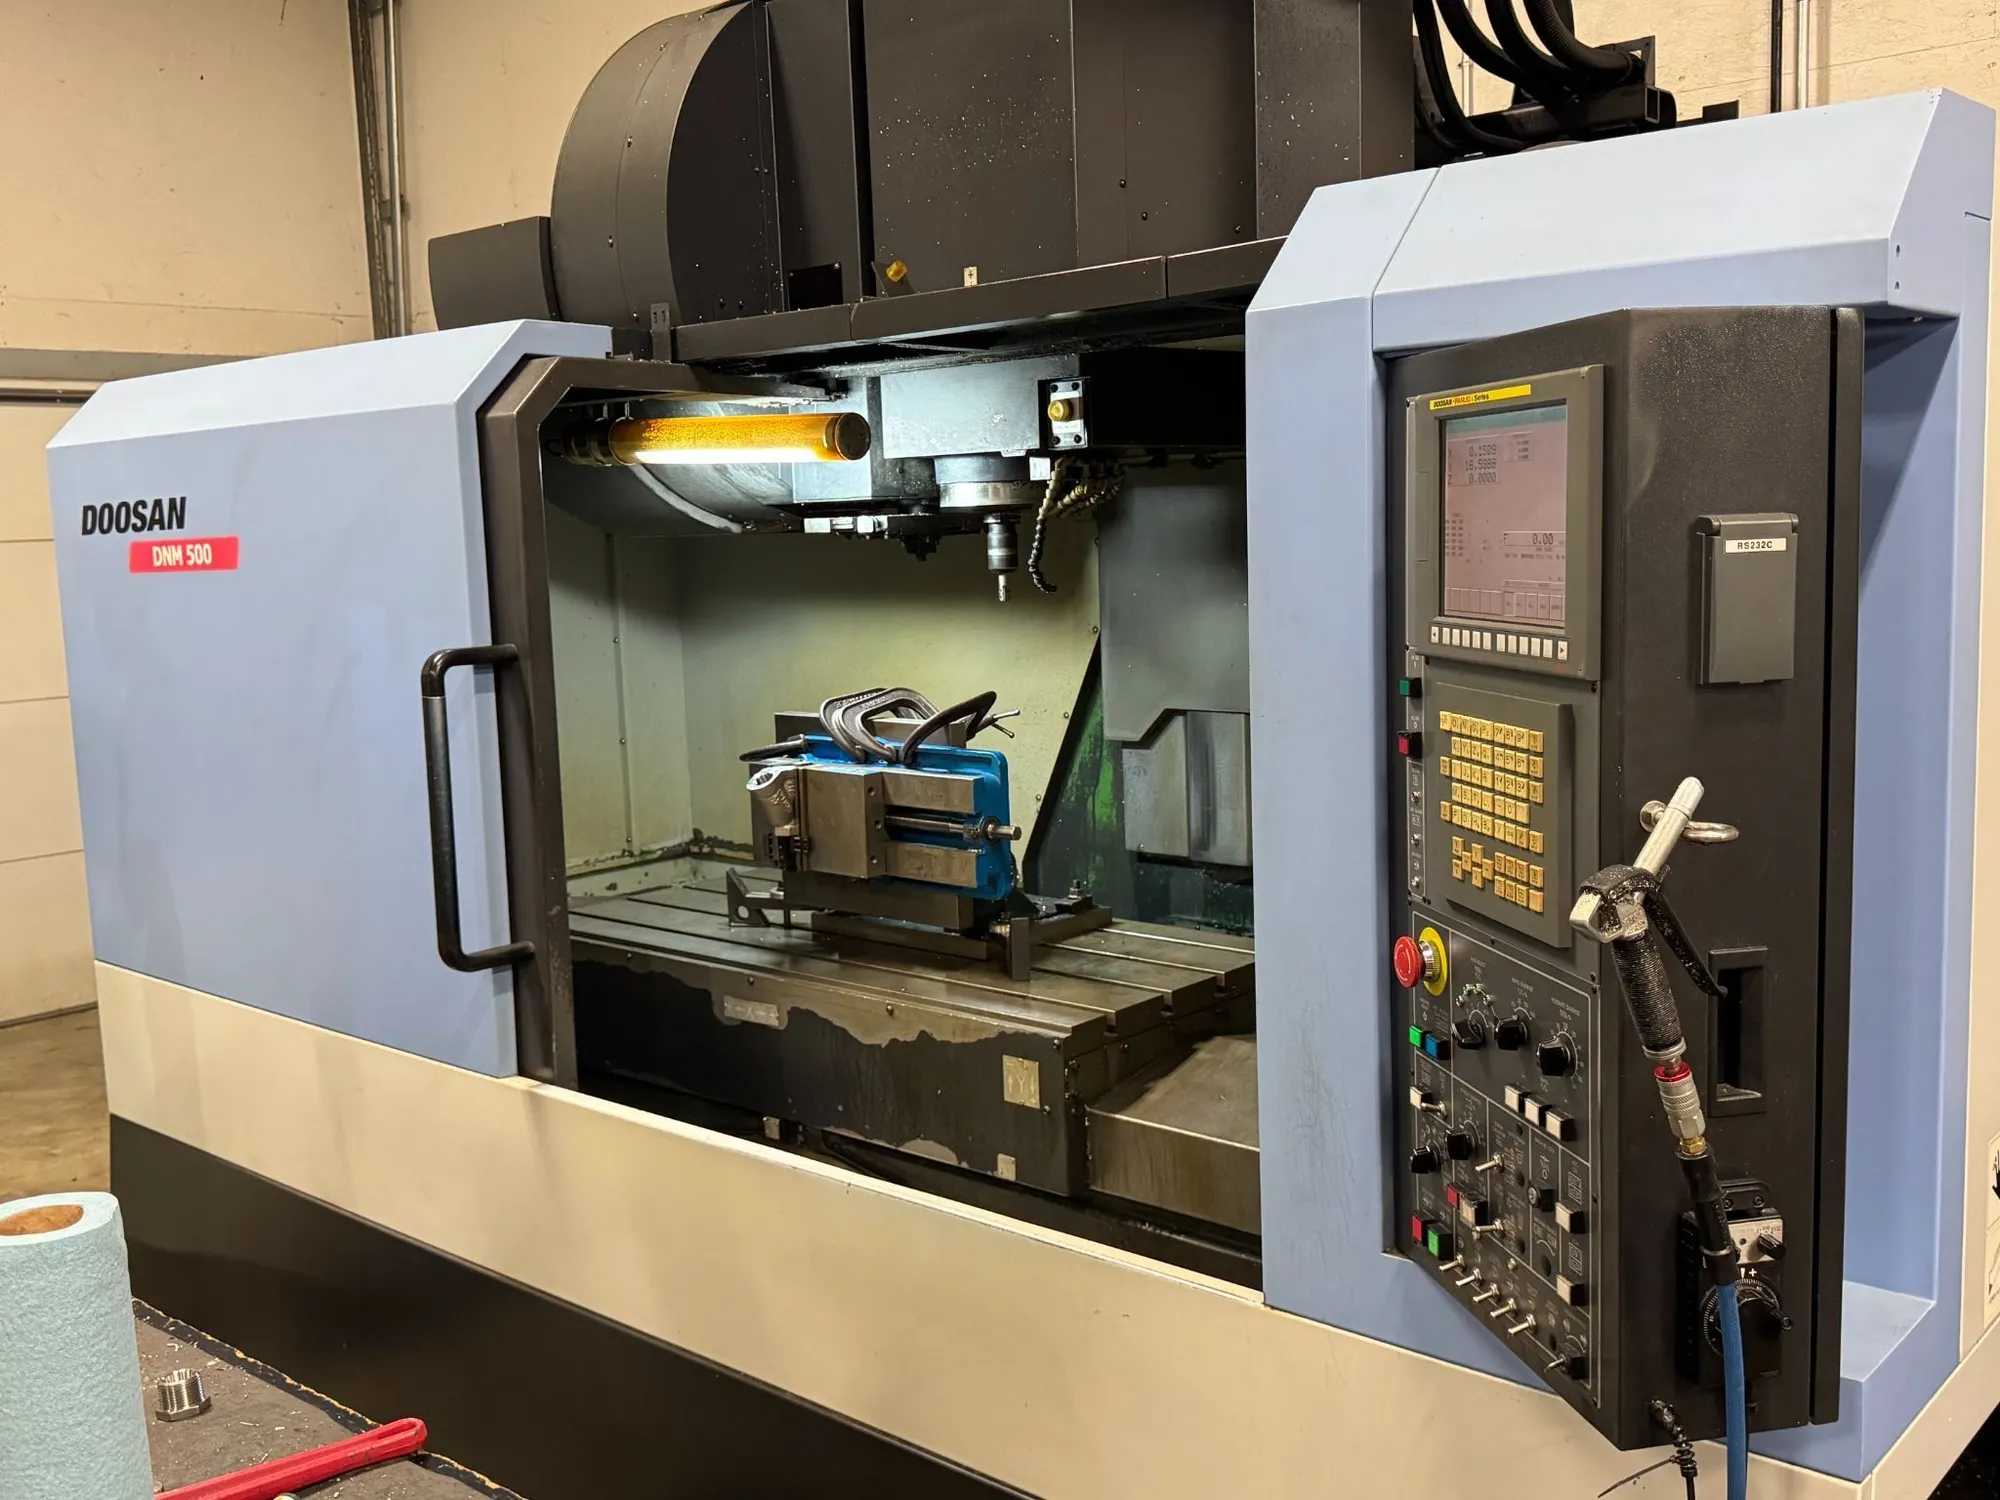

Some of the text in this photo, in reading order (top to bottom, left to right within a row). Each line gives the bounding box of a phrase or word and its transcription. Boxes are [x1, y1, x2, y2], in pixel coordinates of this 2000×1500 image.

[81, 496, 187, 536] DOOSAN
[152, 543, 213, 567] DNM 500
[1737, 541, 1773, 551] RS232C
